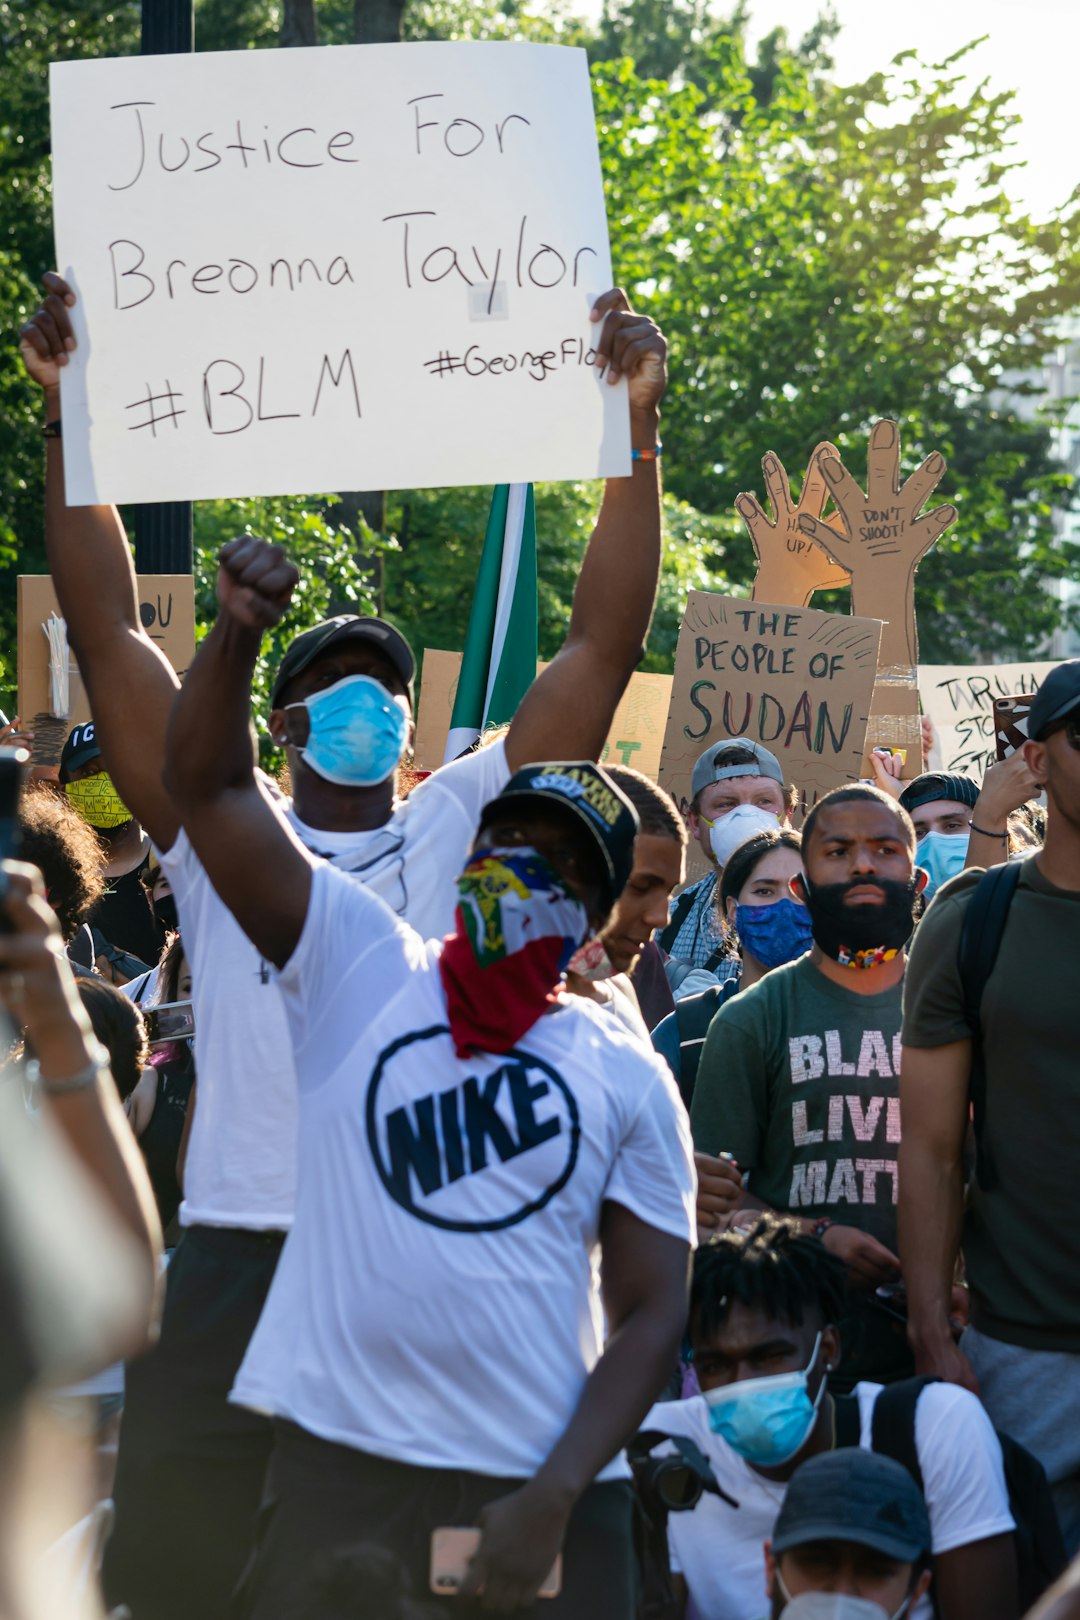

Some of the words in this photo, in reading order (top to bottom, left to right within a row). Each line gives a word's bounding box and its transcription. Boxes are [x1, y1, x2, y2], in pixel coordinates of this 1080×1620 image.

[107, 101, 360, 191] Justice
[407, 93, 531, 157] For
[107, 239, 355, 311] Breonna
[382, 211, 599, 315] Taylor
[423, 336, 605, 381] #GeorgeFlo
[124, 348, 362, 438] #BLM
[859, 520, 905, 542] SHOOT!
[861, 506, 905, 524] DON'T
[786, 538, 814, 558] UP!
[139, 593, 172, 628] OU
[735, 610, 802, 637] THE
[695, 636, 797, 675] PEOPLE
[808, 652, 846, 680] OF
[73, 724, 95, 748] IC
[683, 680, 854, 754] SUDAN
[955, 714, 996, 749] STO
[788, 1028, 902, 1086] BLA
[385, 1063, 561, 1197] NIKE
[788, 1157, 900, 1209] MATT
